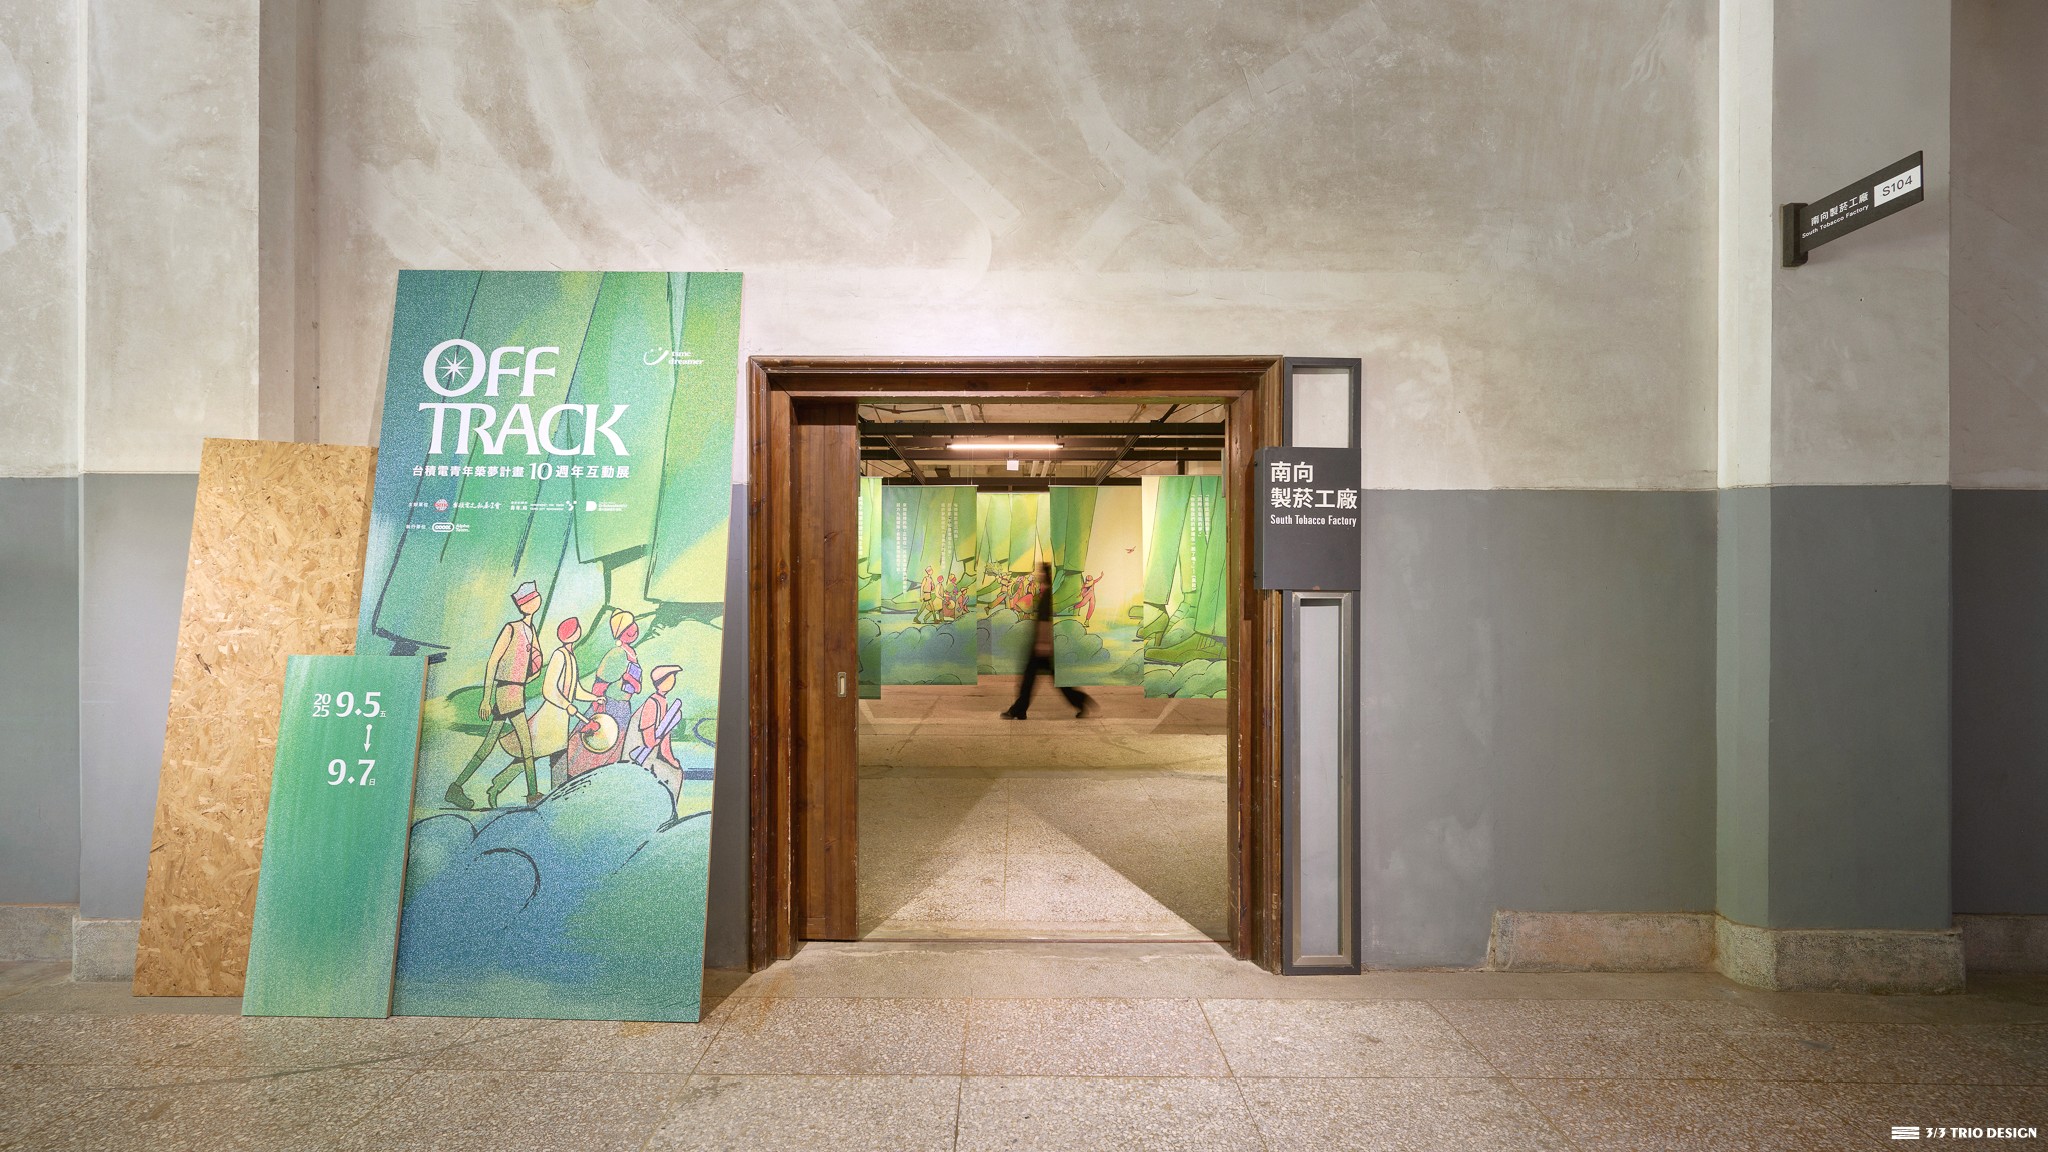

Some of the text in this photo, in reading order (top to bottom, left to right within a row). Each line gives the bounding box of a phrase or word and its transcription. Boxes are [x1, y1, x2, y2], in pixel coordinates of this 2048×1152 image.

[1882, 175, 1912, 197] S104
[1802, 204, 1869, 239] South Tobacco Factory
[1810, 191, 1869, 226] 南向製菸工廠
[422, 338, 560, 398] OFF
[418, 402, 630, 457] TRACK
[1270, 461, 1313, 483] 南向
[1271, 487, 1358, 509] 製菸工廠
[1270, 514, 1357, 527] South Tobacco Factory
